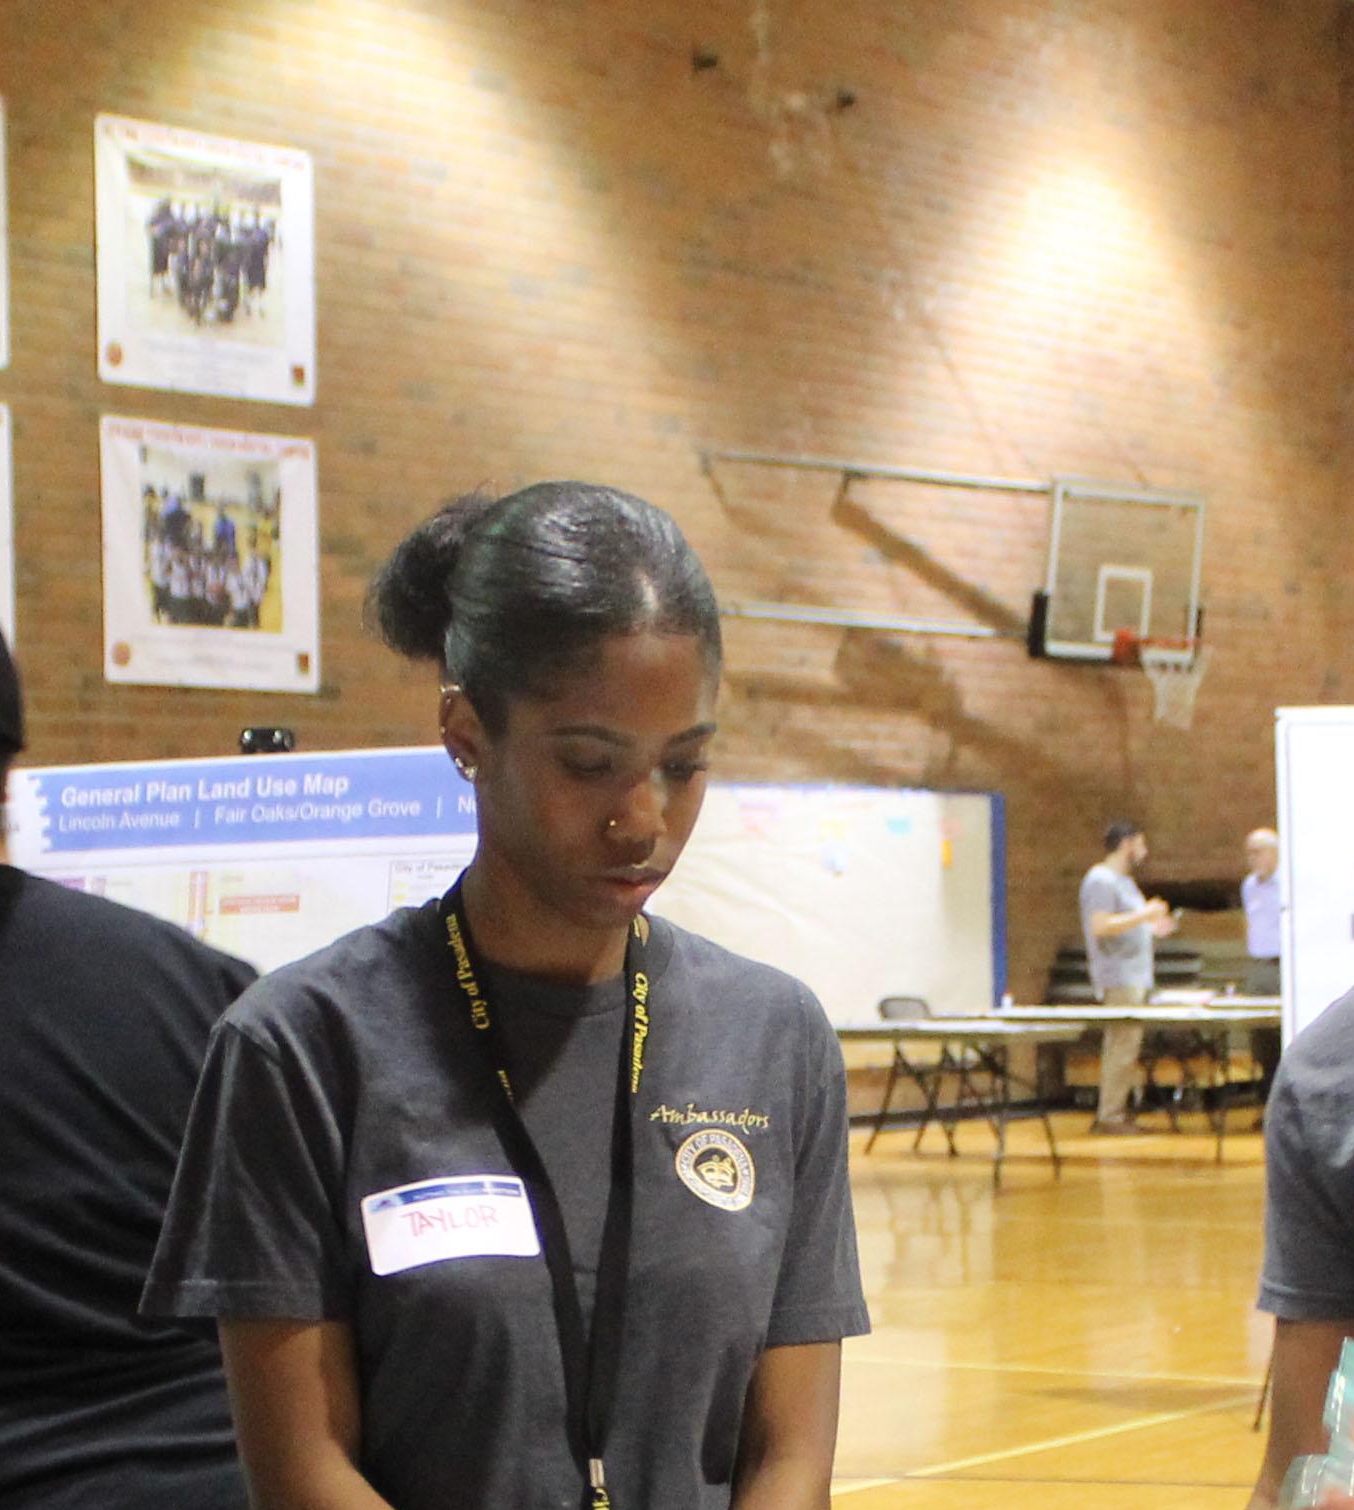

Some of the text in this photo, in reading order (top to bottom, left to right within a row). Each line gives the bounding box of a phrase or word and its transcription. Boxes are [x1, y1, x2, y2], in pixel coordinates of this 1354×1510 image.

[61, 773, 349, 807] General Plan Land Use Map
[58, 809, 116, 834] Lincoln
[117, 807, 180, 829] Avenue
[214, 803, 247, 825] Fair
[251, 800, 364, 824] Oaks/Orange
[368, 797, 421, 819] Grove
[446, 913, 492, 1030] City of Pasadena
[629, 972, 653, 1094] City of Pasadena
[649, 1102, 772, 1135] Ambassadors
[402, 1204, 500, 1238] TAYLOR
